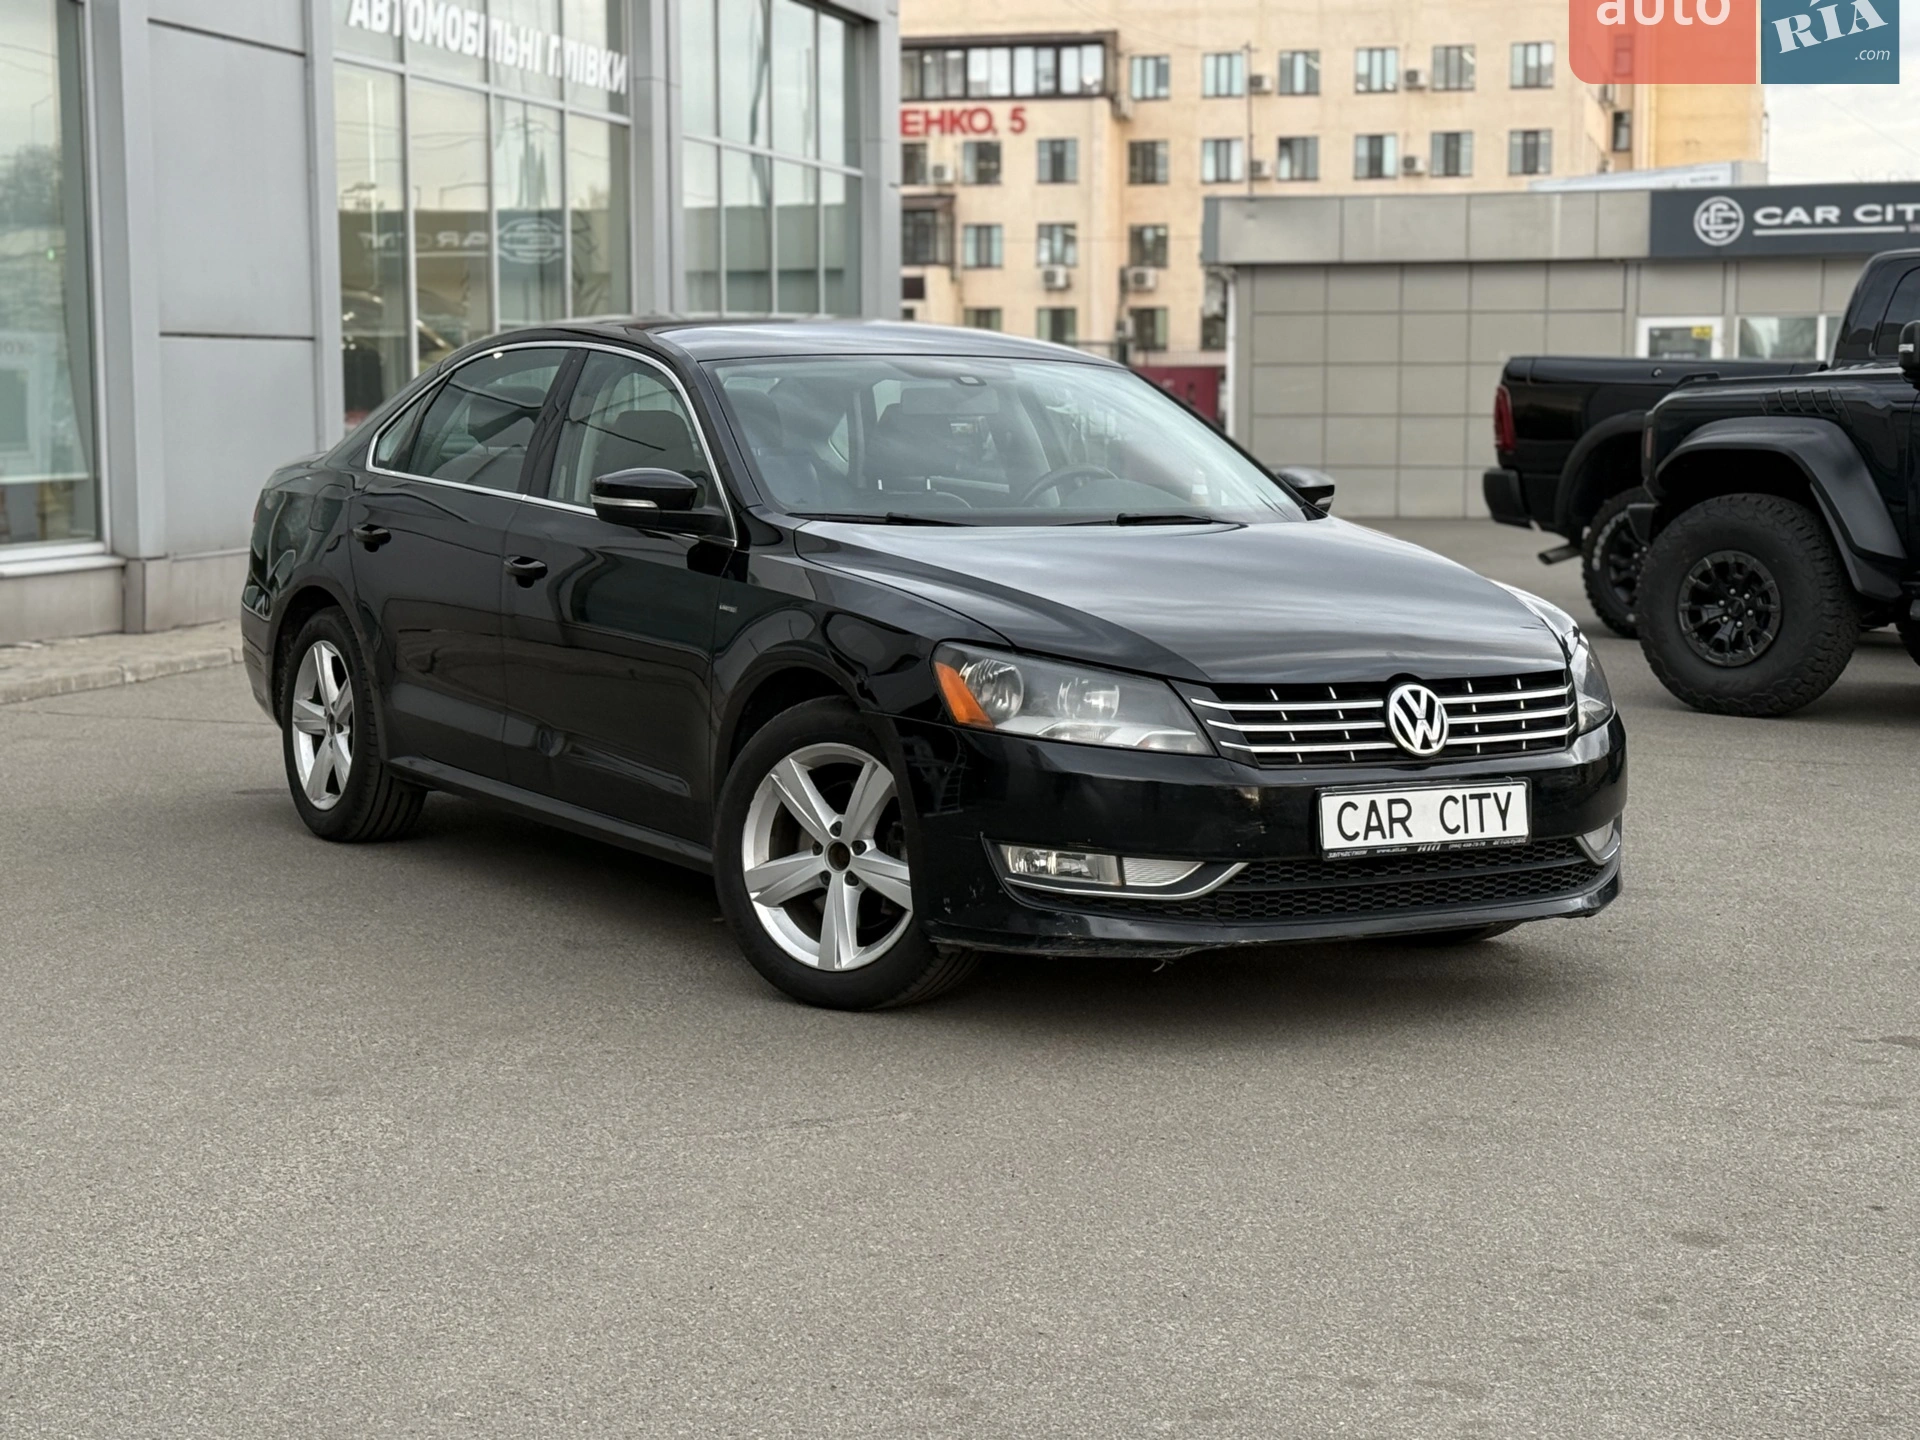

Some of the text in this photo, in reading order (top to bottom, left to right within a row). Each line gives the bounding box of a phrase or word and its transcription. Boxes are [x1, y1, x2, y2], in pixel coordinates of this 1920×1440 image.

[1009, 106, 1027, 135] 5
[1753, 205, 1842, 226] CAR
[1337, 791, 1512, 842] CAR CITY
